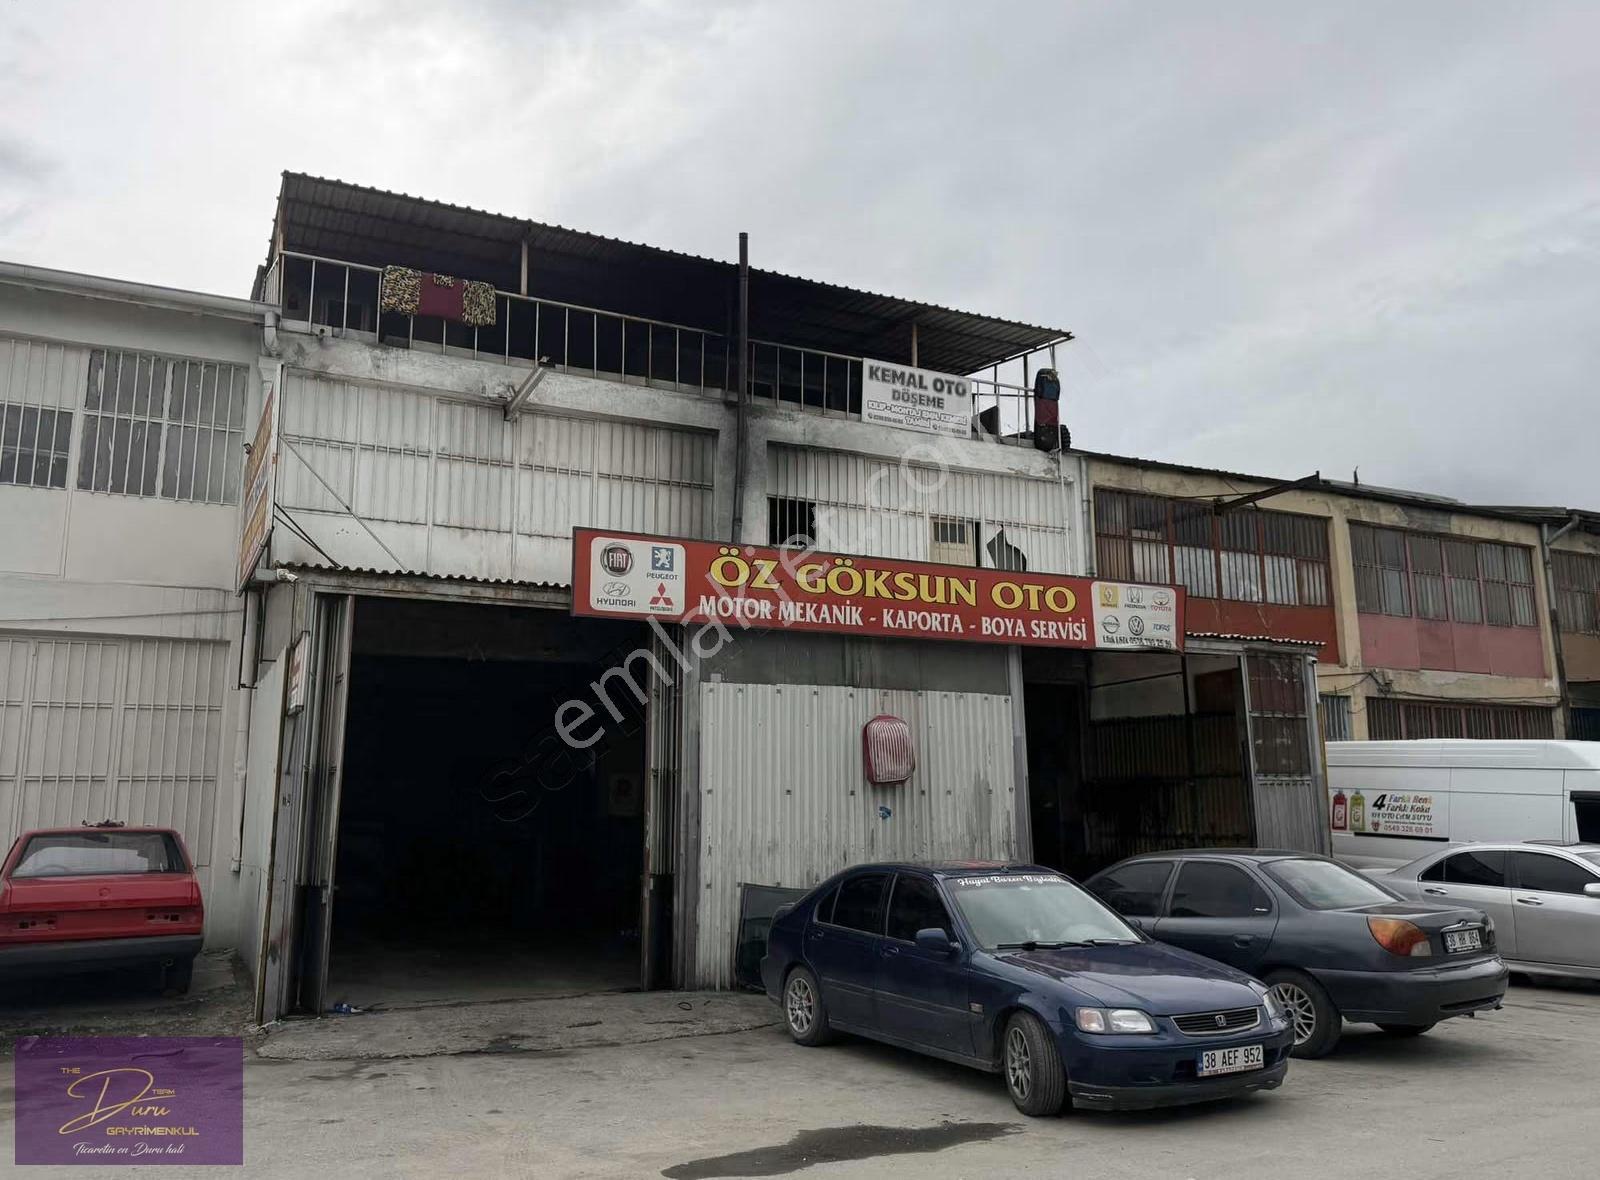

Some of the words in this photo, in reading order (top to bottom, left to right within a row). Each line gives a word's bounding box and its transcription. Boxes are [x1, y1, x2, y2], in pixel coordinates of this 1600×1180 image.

[868, 365, 928, 390] KEMAL
[932, 378, 967, 397] OTO
[892, 388, 945, 410] DÖŞEME
[890, 403, 920, 417] MONTAJ
[608, 552, 628, 568] FIAT
[646, 572, 679, 580] PEUGEOT
[709, 546, 782, 590] ÖZ
[795, 557, 977, 607] GÖKSUN
[991, 581, 1077, 614] OTO
[596, 598, 636, 607] HYUNDAI
[1150, 604, 1172, 612] TOYOTA
[700, 595, 772, 620] MOTOR
[778, 600, 864, 626] MEKANİK
[882, 608, 963, 633] KAPORTA
[981, 616, 1027, 639] BOYA
[1031, 617, 1088, 641] SERVİSİ
[1372, 793, 1387, 810] 4
[958, 876, 991, 887] Hayat
[1204, 1052, 1217, 1069] 38
[1222, 1050, 1239, 1067] AEF
[1243, 1047, 1261, 1063] 952
